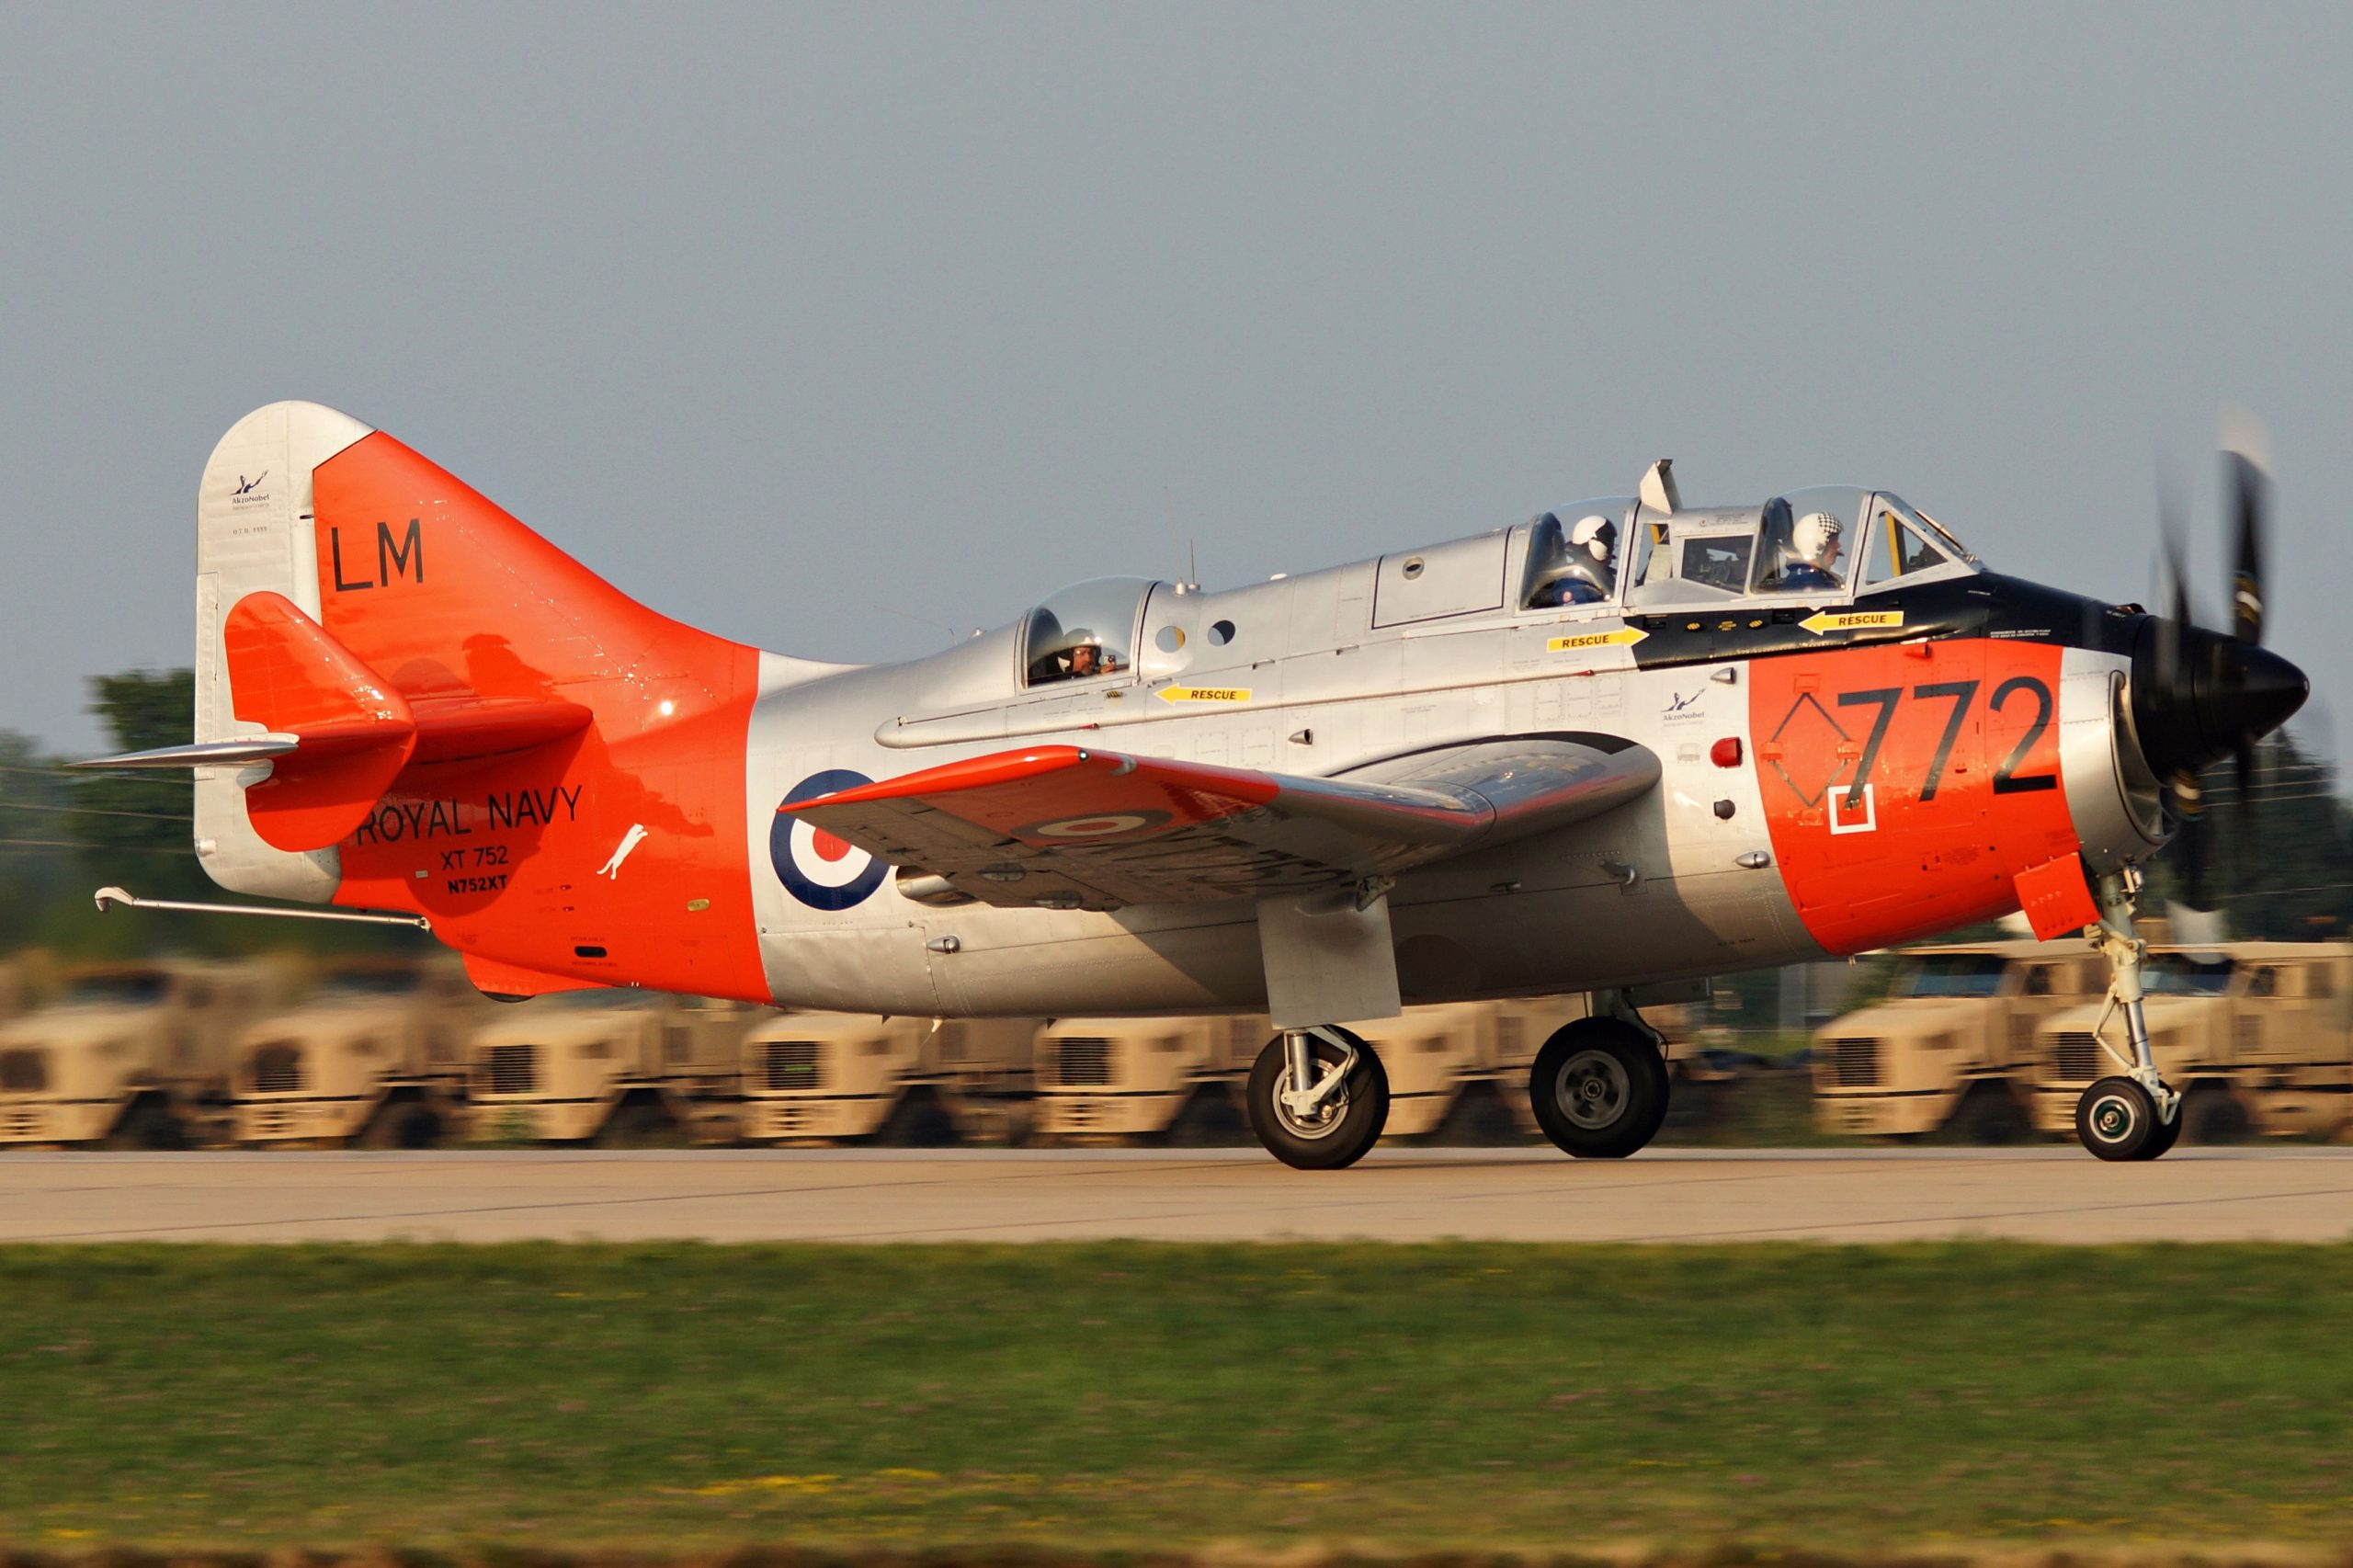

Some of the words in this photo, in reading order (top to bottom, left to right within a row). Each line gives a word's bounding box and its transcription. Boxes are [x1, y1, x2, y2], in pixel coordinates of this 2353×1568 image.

[232, 494, 270, 505] AkzoNobel
[331, 518, 424, 592] LM
[1838, 614, 1888, 627] RESCUE
[1562, 634, 1610, 648] RESCUE
[1189, 688, 1237, 700] RESCUE
[1837, 676, 2058, 810] 772
[356, 799, 472, 846] ROYAL
[488, 785, 583, 831] NAVY
[440, 849, 466, 870] XT
[473, 845, 509, 867] 752
[447, 874, 508, 894] N752XT
